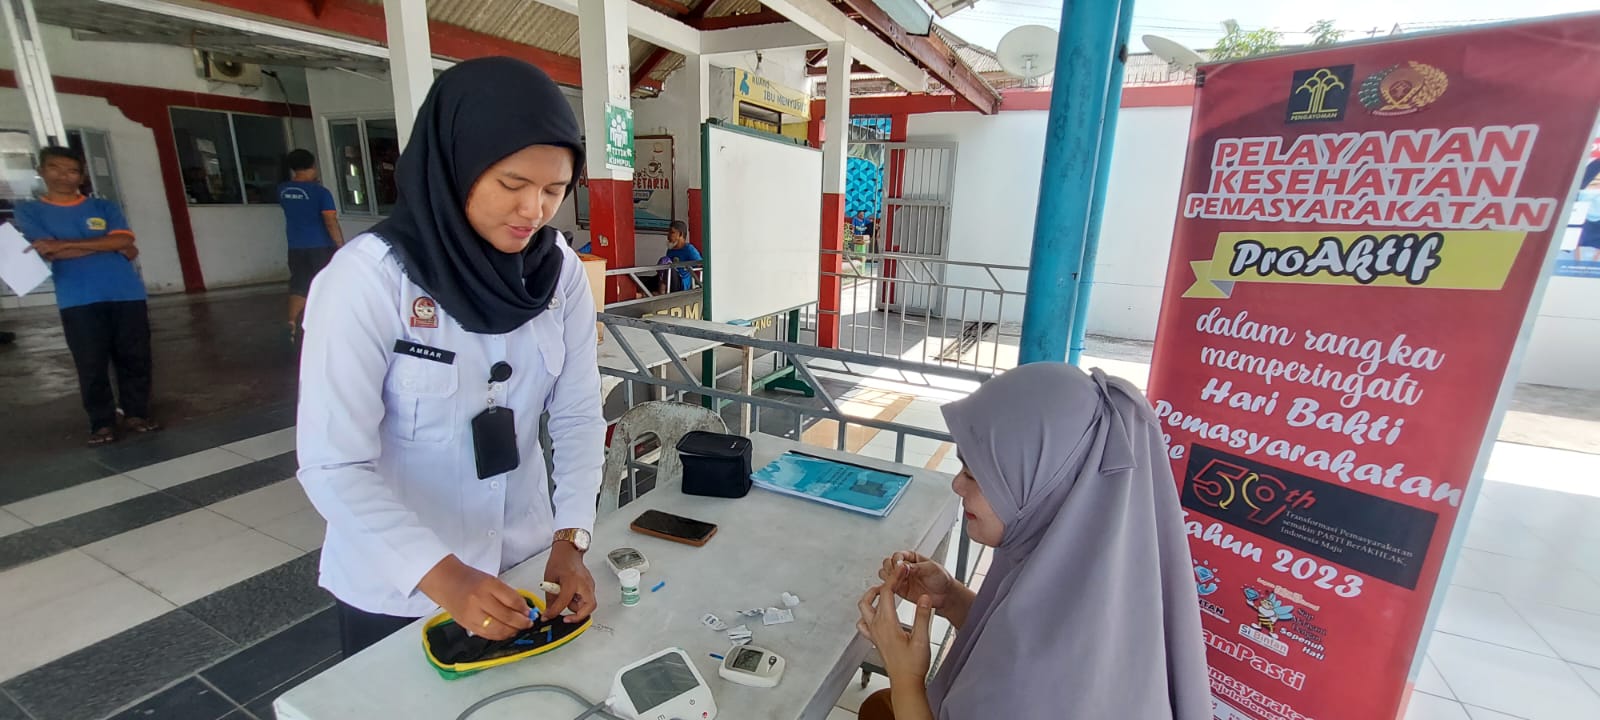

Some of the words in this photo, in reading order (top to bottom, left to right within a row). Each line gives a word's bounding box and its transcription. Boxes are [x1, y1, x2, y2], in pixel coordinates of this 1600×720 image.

[1213, 127, 1536, 168] PELAYANAN
[1211, 164, 1522, 198] KESEHATAN
[1185, 195, 1553, 229] PEMASYARAKATAN
[1231, 234, 1441, 283] ProAktif
[409, 346, 442, 359] AMBAR
[1196, 306, 1296, 346] dalam
[1304, 328, 1445, 376] rangka
[1201, 346, 1423, 408] memperingati
[1201, 377, 1280, 416] Hari
[1286, 397, 1405, 445] Bakti
[1154, 400, 1462, 507] Pemasyarakatan
[1182, 511, 1262, 563] ahun
[1280, 526, 1319, 545] Indonesia
[1321, 541, 1343, 553] Maju
[1283, 519, 1315, 534] semakin
[1317, 530, 1344, 545] PASTI
[1285, 510, 1338, 533] Transformasi
[1340, 528, 1413, 557] Pemasyarakatan
[1271, 549, 1364, 597] 2023
[1302, 646, 1325, 660] Hati
